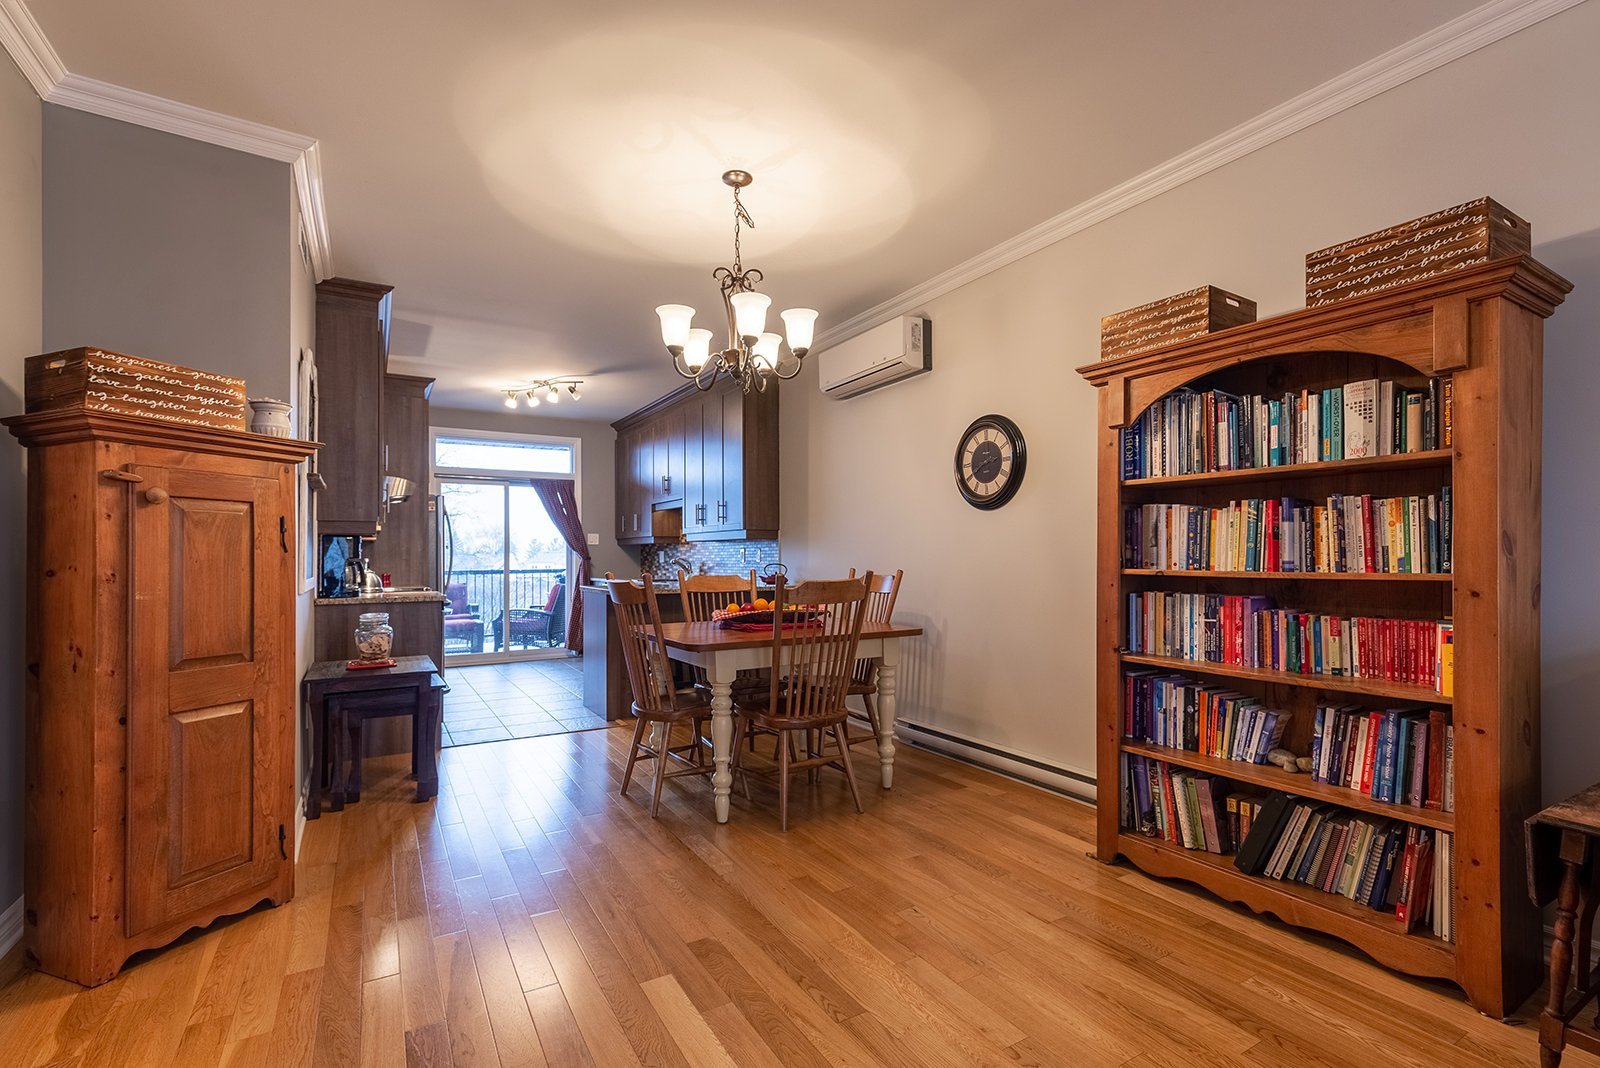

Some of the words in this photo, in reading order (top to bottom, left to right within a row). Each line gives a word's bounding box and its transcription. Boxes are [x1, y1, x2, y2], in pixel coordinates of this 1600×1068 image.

[1410, 198, 1486, 230] grateful
[1347, 240, 1400, 262] gather
[1414, 215, 1486, 242] family
[1307, 274, 1338, 286] love
[1348, 257, 1392, 277] home
[1350, 446, 1368, 456] 2000
[1125, 464, 1134, 476] LE
